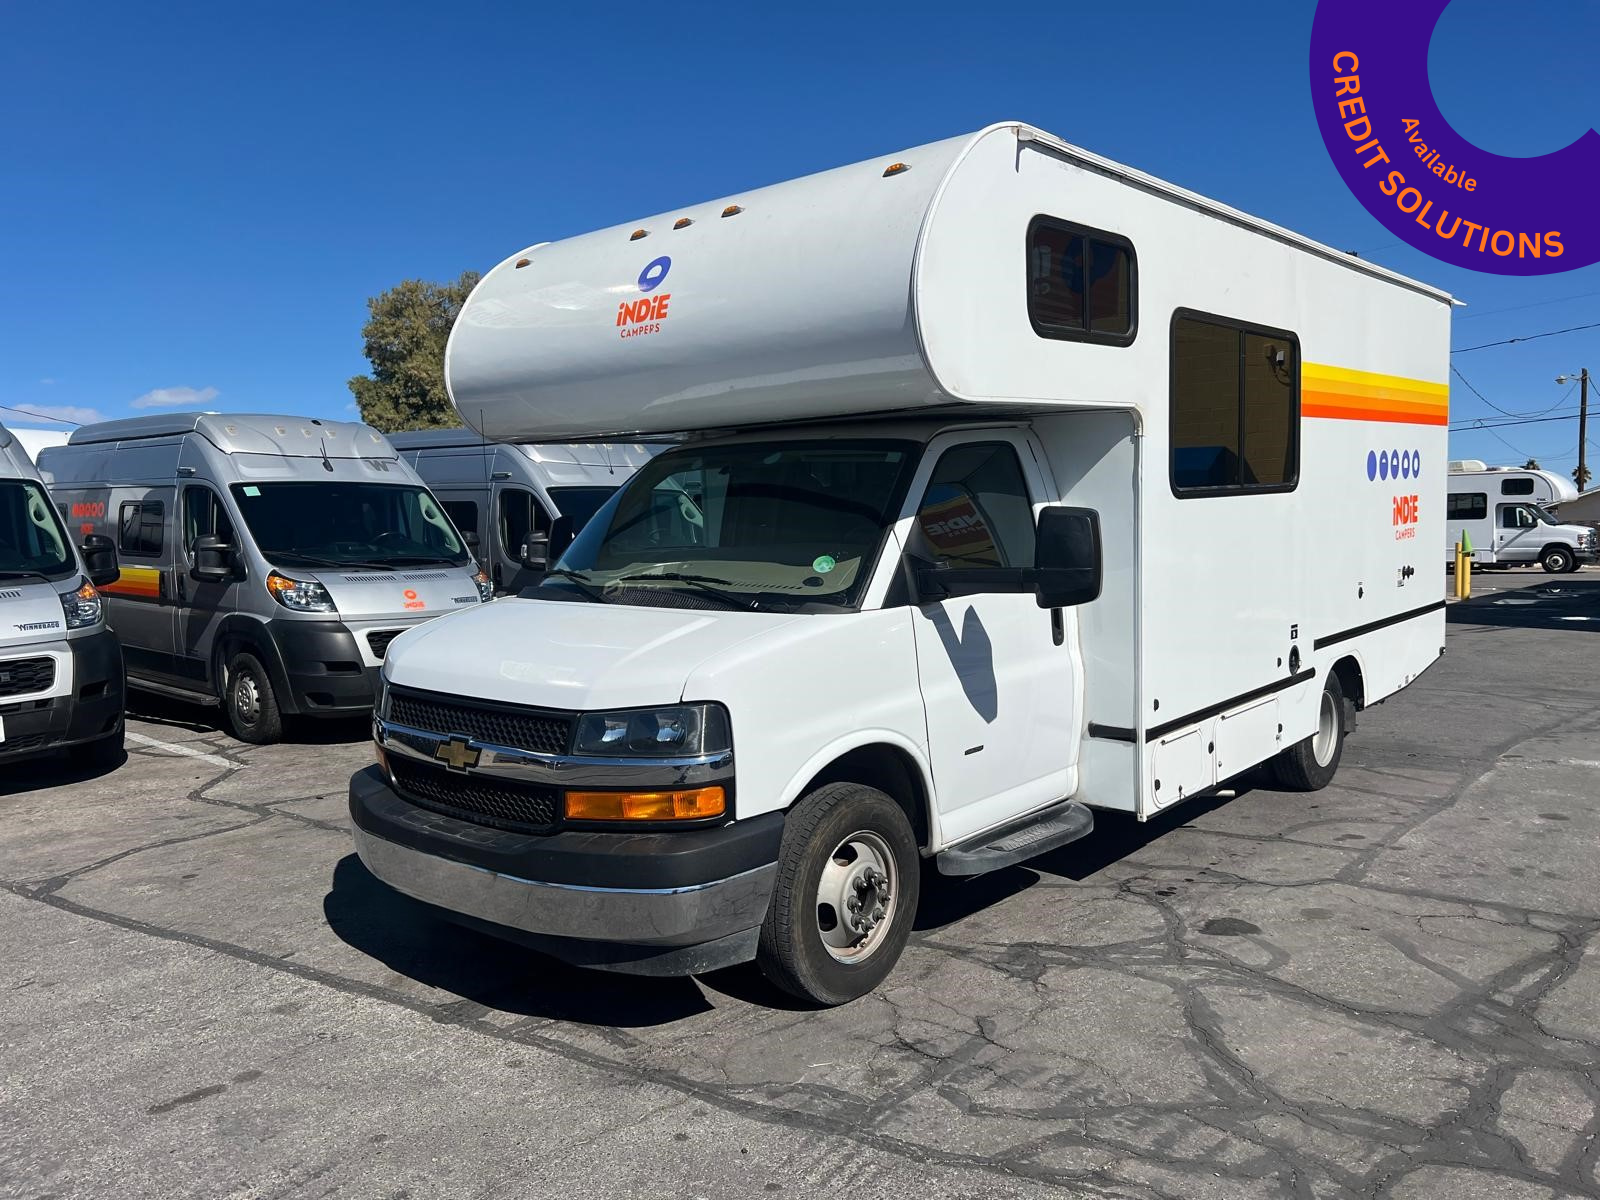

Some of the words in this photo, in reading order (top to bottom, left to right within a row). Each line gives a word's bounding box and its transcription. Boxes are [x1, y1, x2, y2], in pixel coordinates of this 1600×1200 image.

[620, 323, 660, 338] CAMPERS
[1395, 527, 1415, 540] CAMPERS
[13, 620, 59, 631] WINNEBAGO
